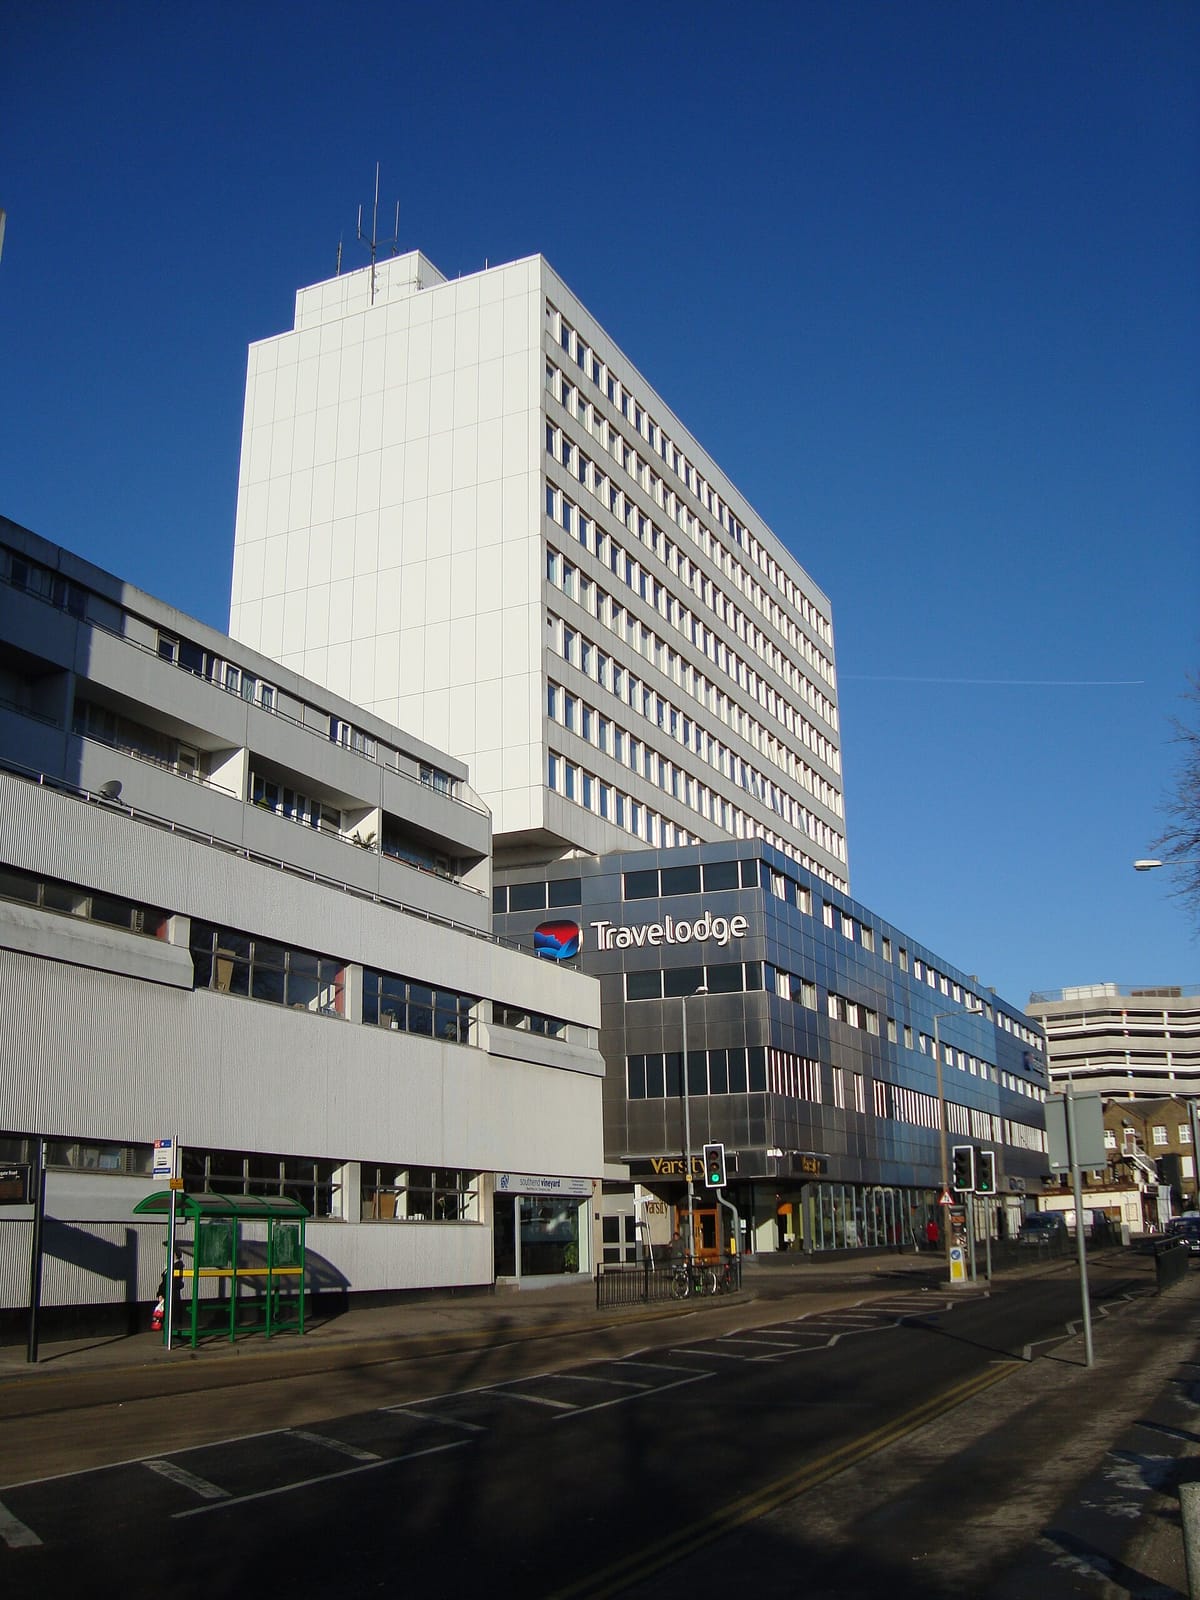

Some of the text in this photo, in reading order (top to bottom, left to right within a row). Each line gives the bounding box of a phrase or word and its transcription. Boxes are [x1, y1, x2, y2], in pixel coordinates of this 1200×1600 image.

[590, 910, 749, 950] Travelodge
[650, 1156, 705, 1177] Varsty
[541, 1177, 561, 1189] vineyard
